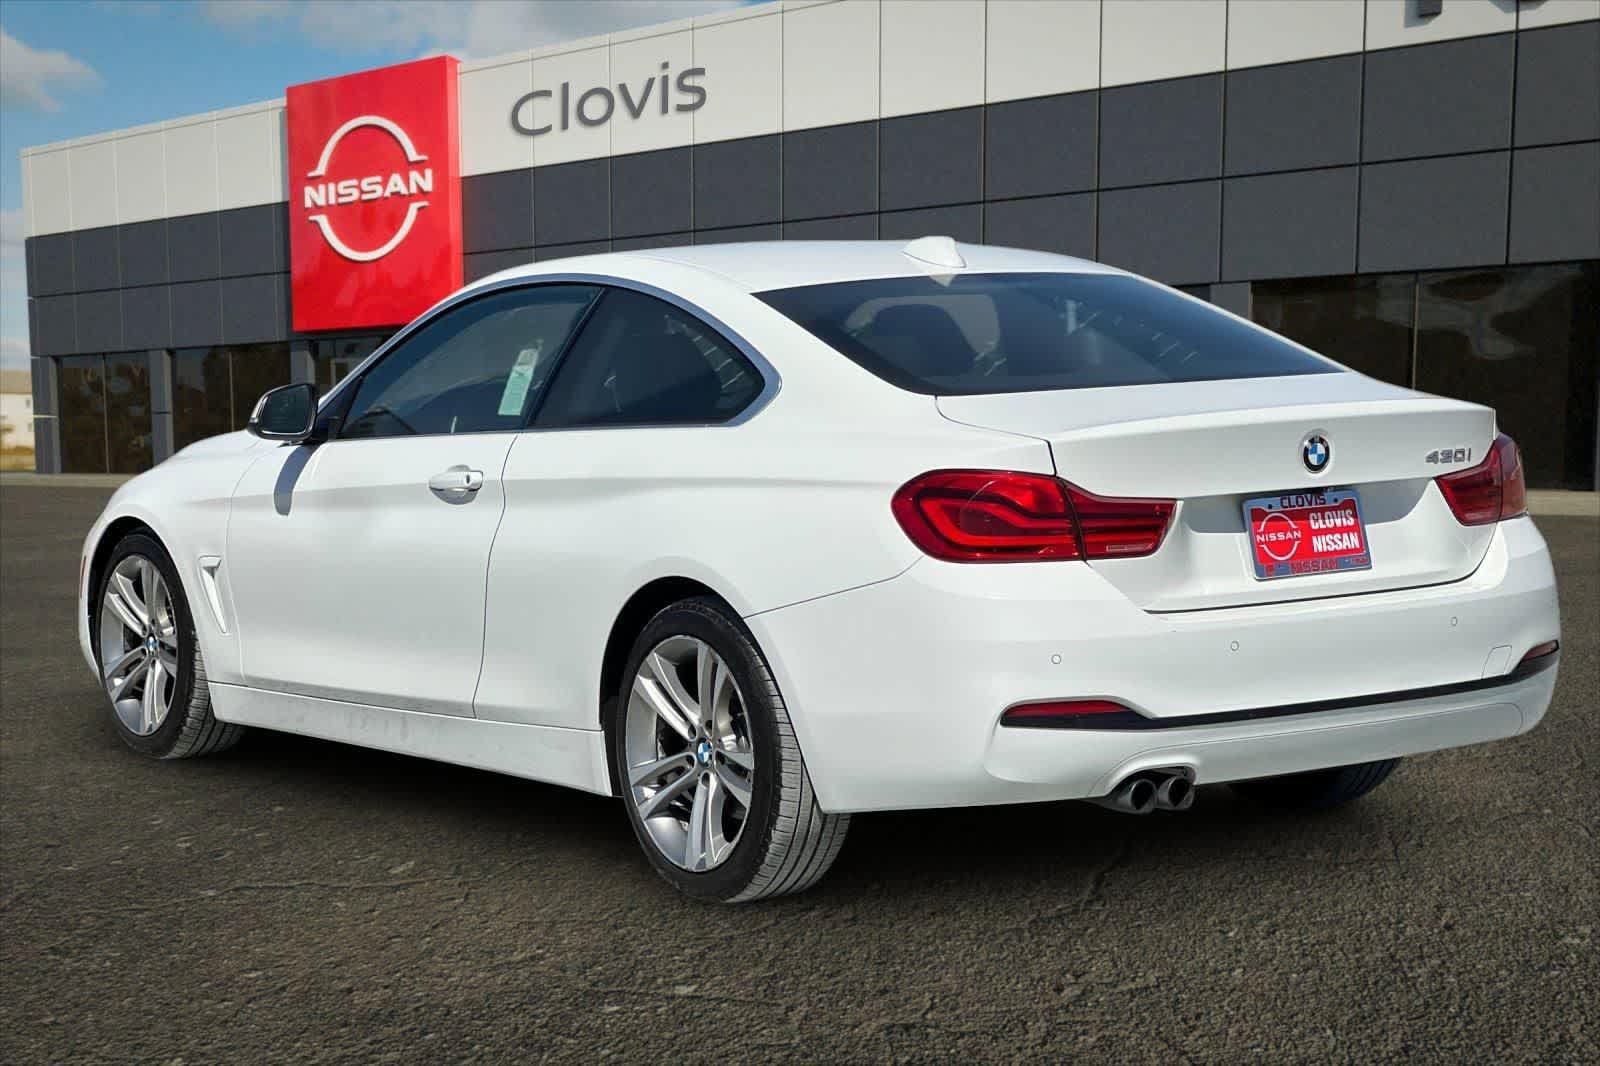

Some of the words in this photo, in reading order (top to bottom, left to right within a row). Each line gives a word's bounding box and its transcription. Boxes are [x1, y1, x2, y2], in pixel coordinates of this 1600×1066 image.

[511, 61, 707, 136] Clovis
[303, 168, 433, 208] NISSAN
[1280, 495, 1327, 508] CLOVIS
[1309, 509, 1355, 529] CLOVIS
[1256, 530, 1302, 543] NISSAN
[1312, 532, 1360, 553] NISSAN
